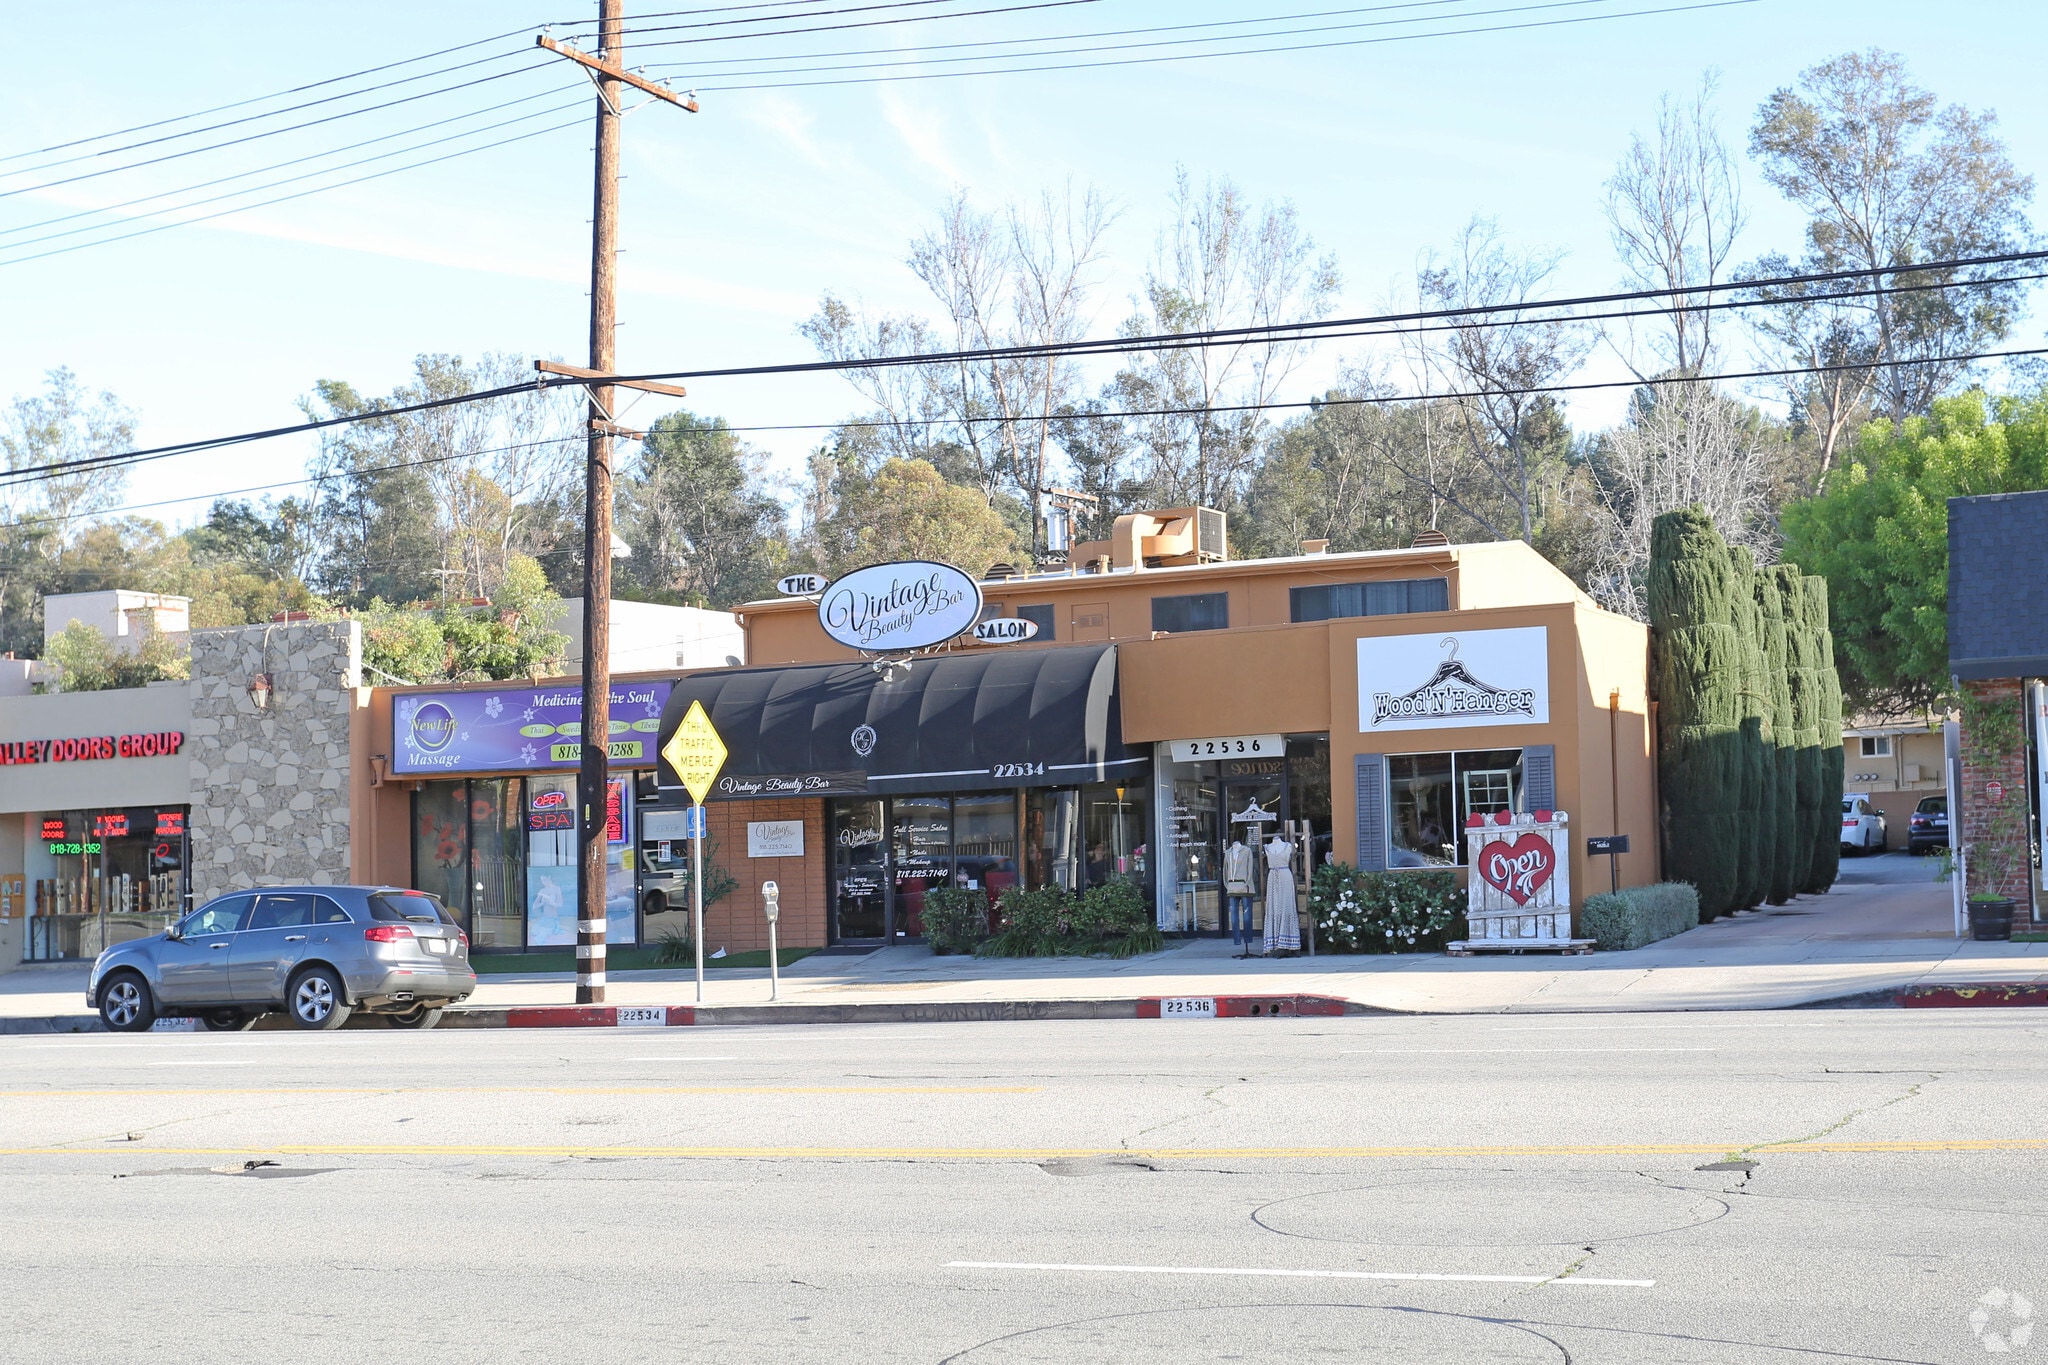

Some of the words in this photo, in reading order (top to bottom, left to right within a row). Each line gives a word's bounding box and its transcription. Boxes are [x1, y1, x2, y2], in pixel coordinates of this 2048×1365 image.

[784, 577, 816, 593] THE
[826, 573, 941, 632] Vintage
[928, 589, 964, 615] Bar
[859, 610, 915, 644] Beauty
[976, 622, 1028, 639] SALON
[532, 693, 582, 707] Medicine
[627, 690, 655, 704] Soul
[530, 726, 544, 734] Thai
[53, 736, 115, 762] DOORS
[118, 731, 183, 758] GROUP
[681, 738, 714, 749] TRAFFIC
[1190, 740, 1260, 755] 22536
[407, 753, 460, 768] Massage
[681, 756, 713, 767] MERGE
[994, 762, 1044, 778] 22534
[687, 773, 710, 784] RIGHT
[719, 776, 762, 794] Vintage
[766, 778, 803, 793] Beauty
[805, 776, 829, 789] Bar
[535, 795, 562, 806] OPEN
[44, 821, 64, 829] WOOD
[531, 814, 569, 828] SPA
[42, 830, 65, 839] DOORS
[50, 843, 101, 855] 818-728-1352
[896, 869, 948, 878] 818.225.7140
[1489, 849, 1547, 895] Open
[1167, 1001, 1210, 1013] 22536
[623, 1010, 660, 1021] 22534
